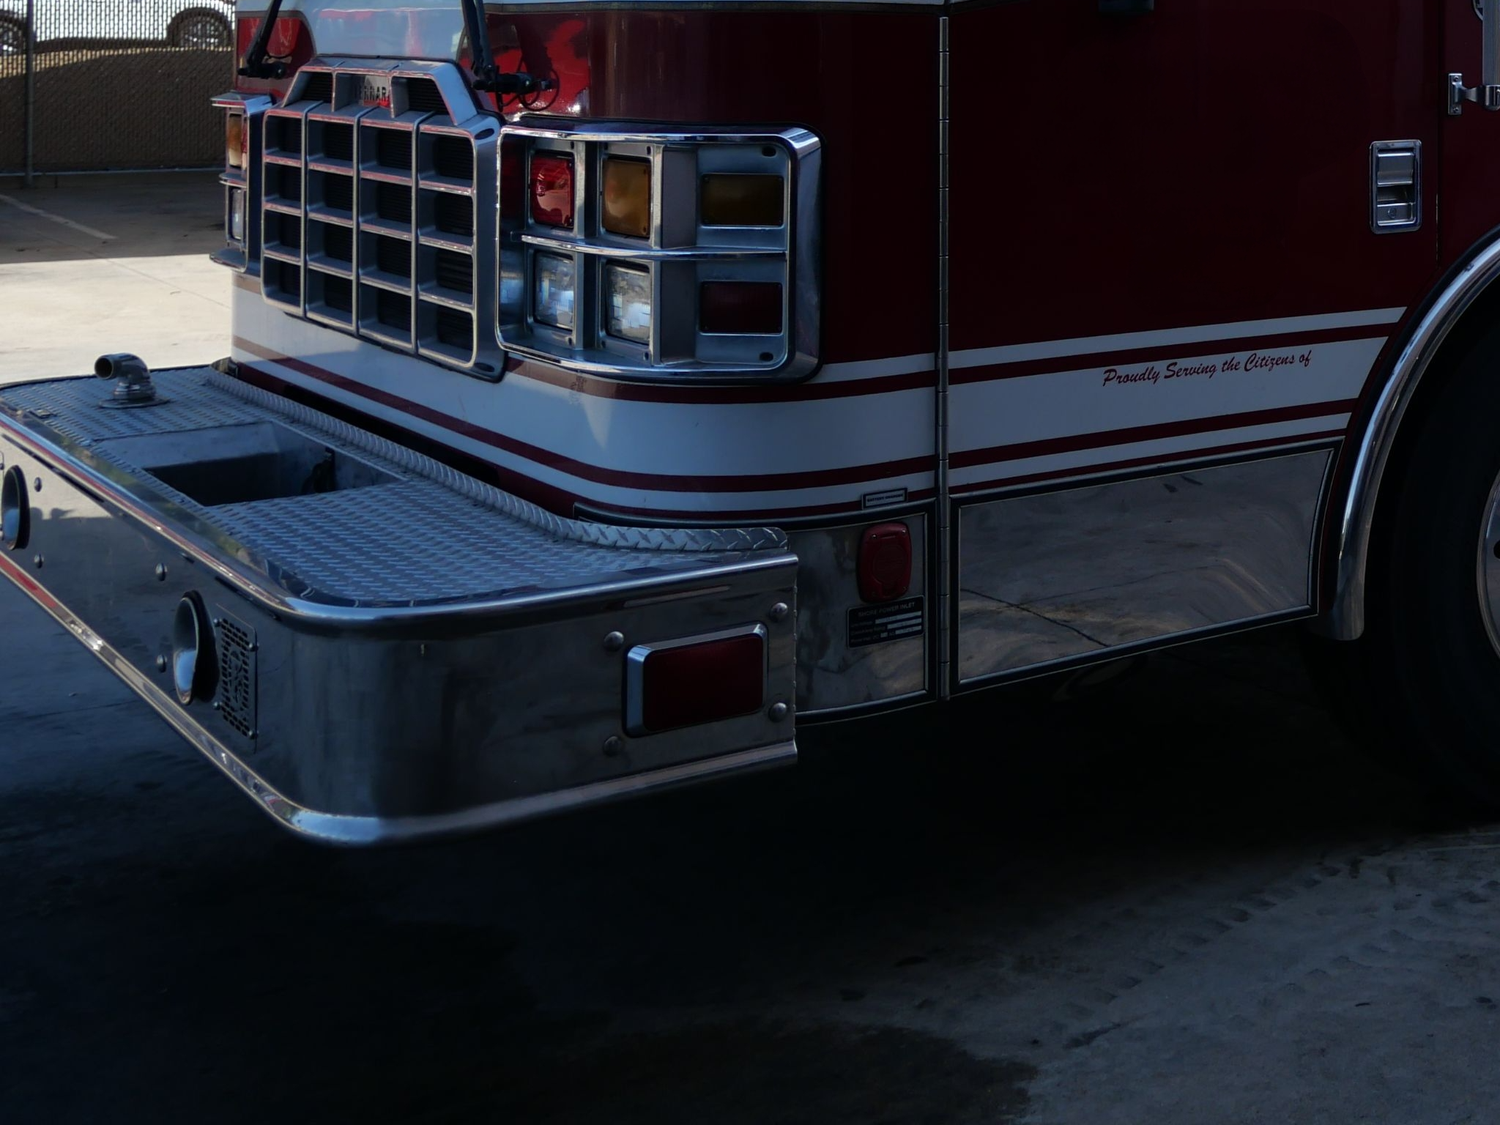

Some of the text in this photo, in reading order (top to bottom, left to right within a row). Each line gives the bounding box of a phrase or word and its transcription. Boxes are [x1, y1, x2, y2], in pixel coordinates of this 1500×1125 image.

[1102, 350, 1312, 386] Proudly Serving the Citizens of
